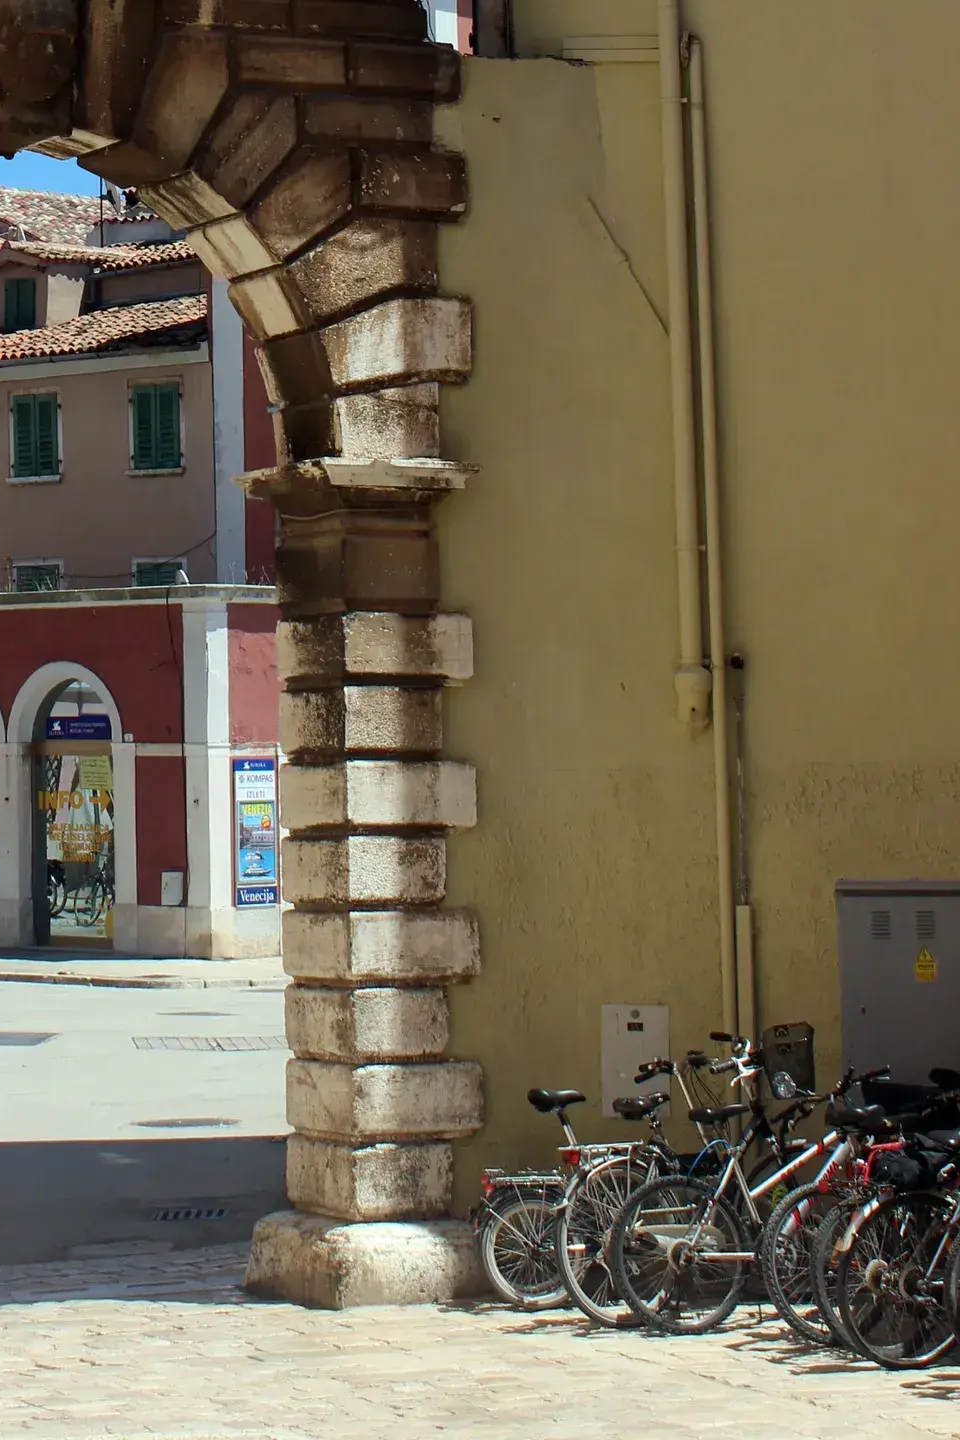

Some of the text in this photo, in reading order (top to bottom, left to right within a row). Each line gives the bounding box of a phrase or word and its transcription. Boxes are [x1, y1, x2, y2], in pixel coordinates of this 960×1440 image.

[246, 774, 274, 783] KOMPAS
[37, 790, 84, 810] INFO
[246, 790, 266, 799] IZLETI
[240, 889, 275, 904] Venecija
